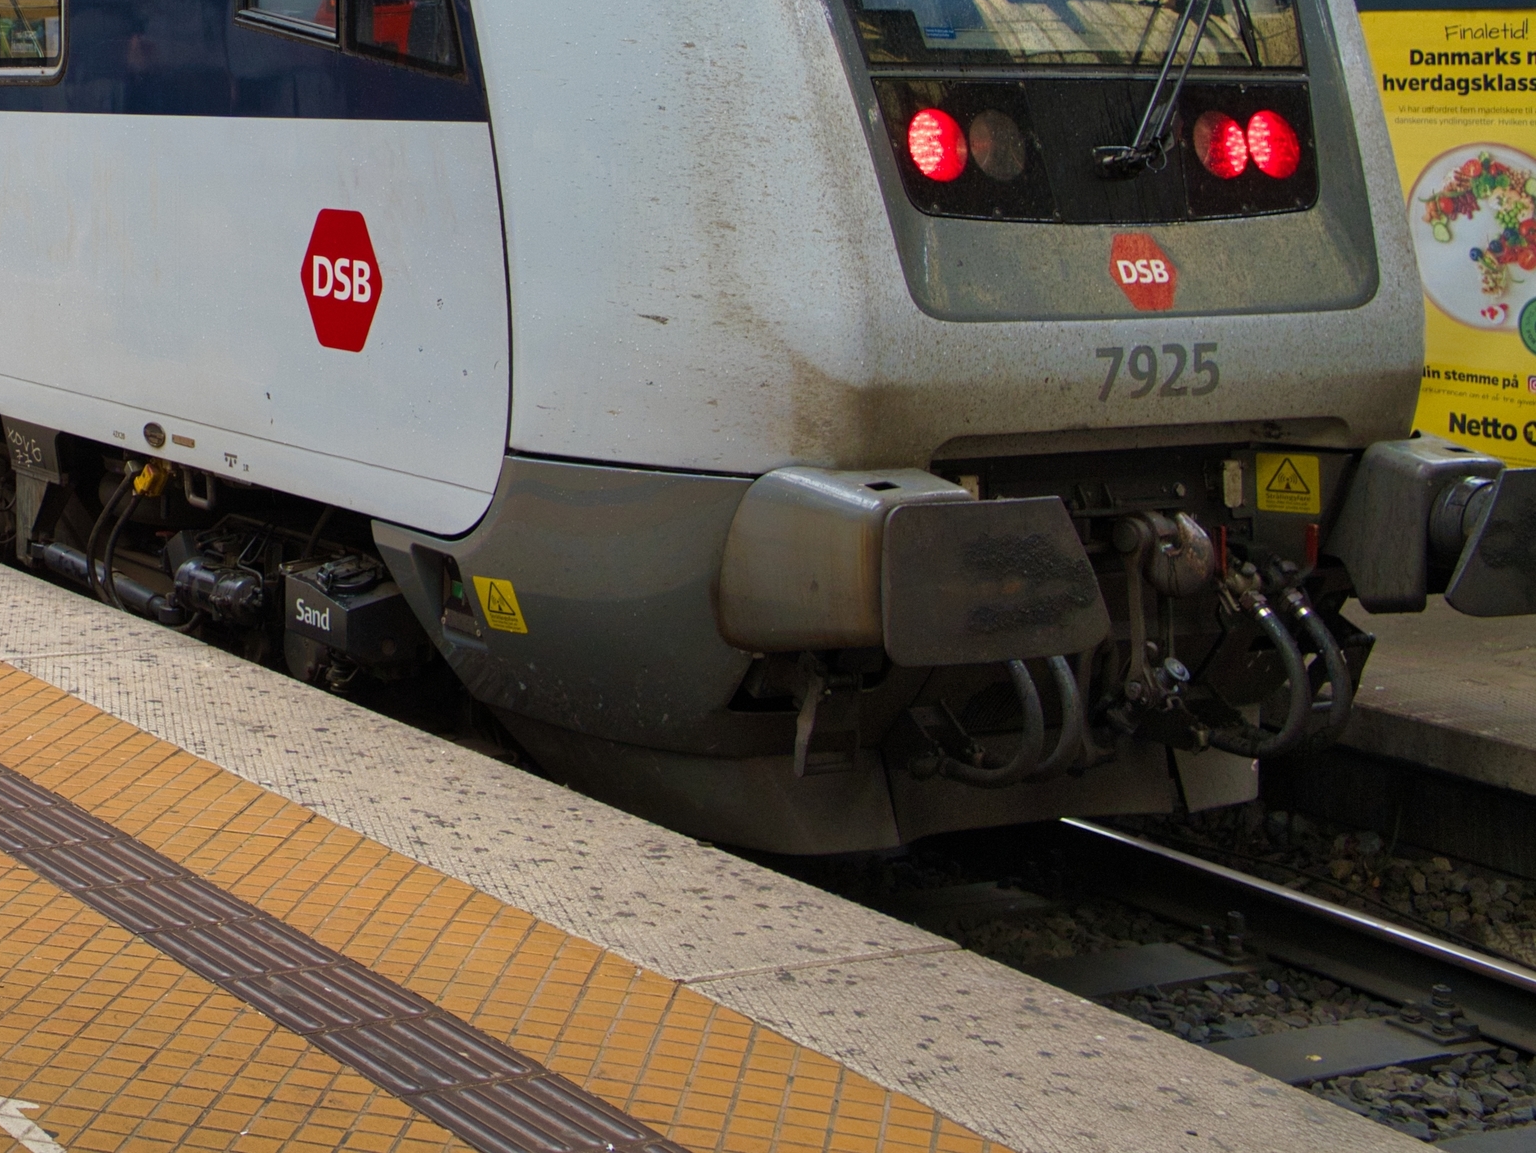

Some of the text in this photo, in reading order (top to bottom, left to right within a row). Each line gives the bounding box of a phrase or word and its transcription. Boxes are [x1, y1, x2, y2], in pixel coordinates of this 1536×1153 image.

[1444, 18, 1529, 41] Finaletid!
[1409, 47, 1521, 66] Danmarks
[1394, 116, 1438, 125] danskernes
[313, 255, 372, 303] DSB
[1116, 259, 1170, 284] DSB
[1096, 342, 1220, 402] 7925
[1444, 370, 1499, 386] stemme
[1502, 374, 1519, 390] på
[1449, 411, 1518, 441] Netto
[296, 597, 331, 632] Sand
